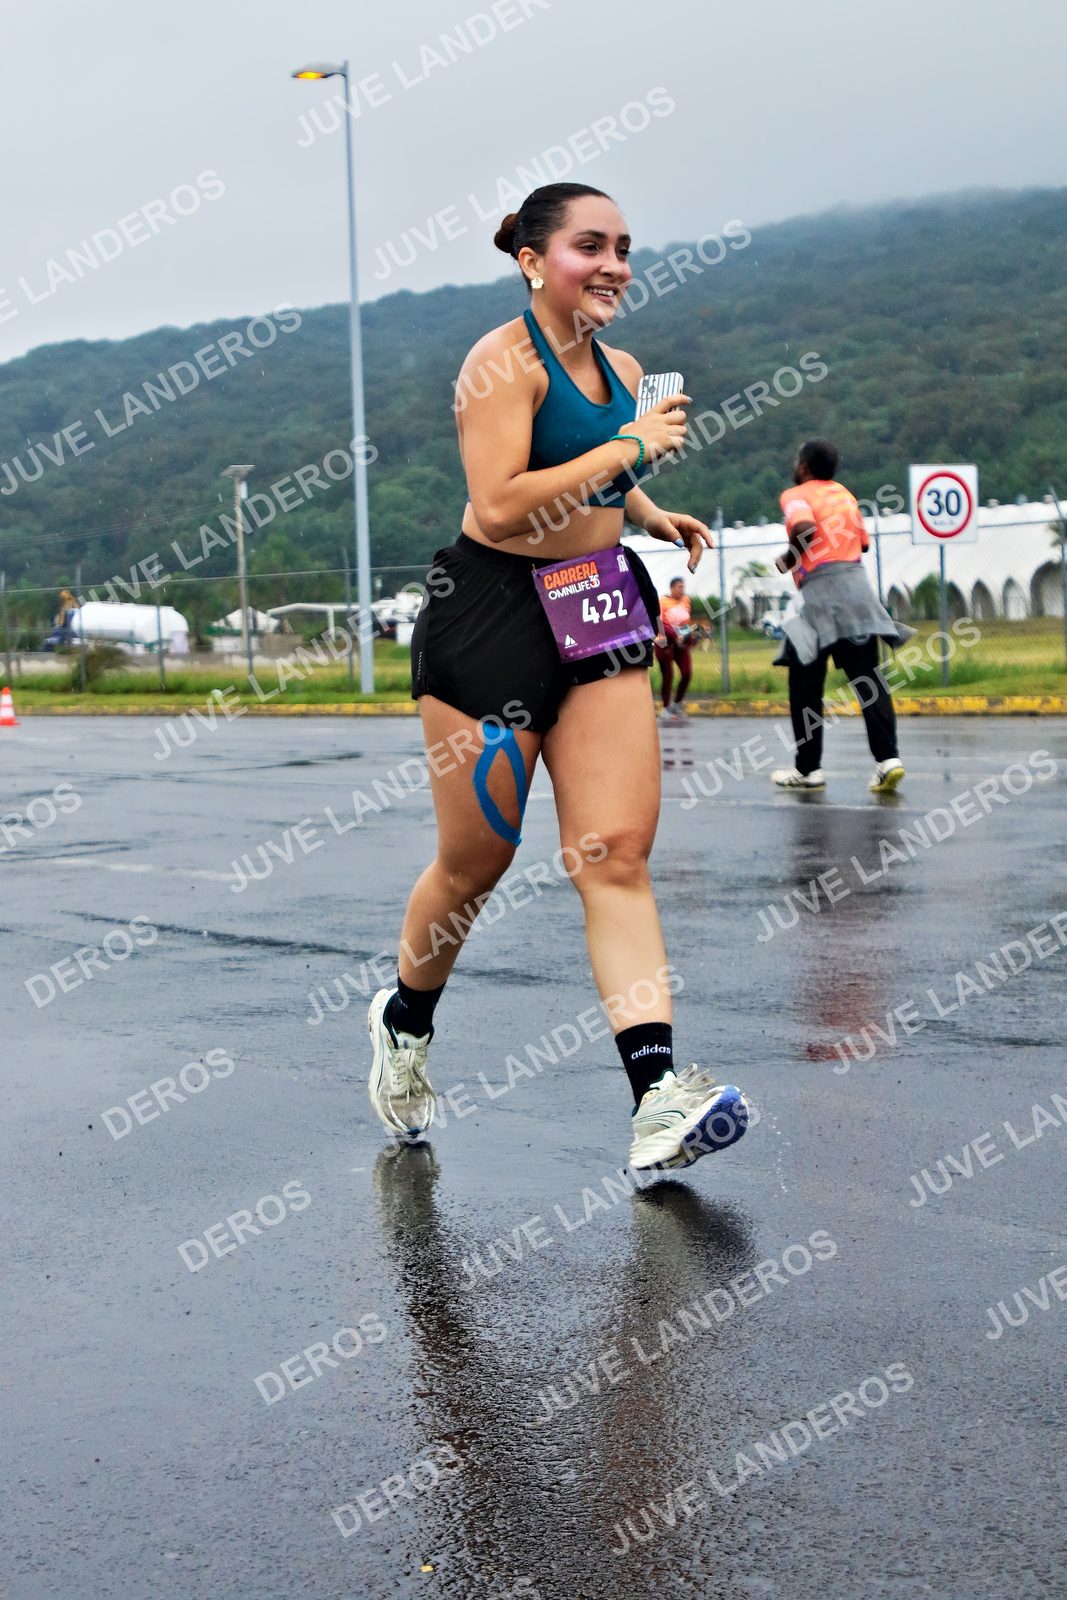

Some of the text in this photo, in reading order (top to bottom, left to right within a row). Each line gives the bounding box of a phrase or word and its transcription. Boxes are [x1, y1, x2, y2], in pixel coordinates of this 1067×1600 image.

[927, 488, 962, 516] 30
[543, 560, 599, 590] CARRERA
[582, 589, 628, 624] 422
[631, 1044, 671, 1060] adidas
